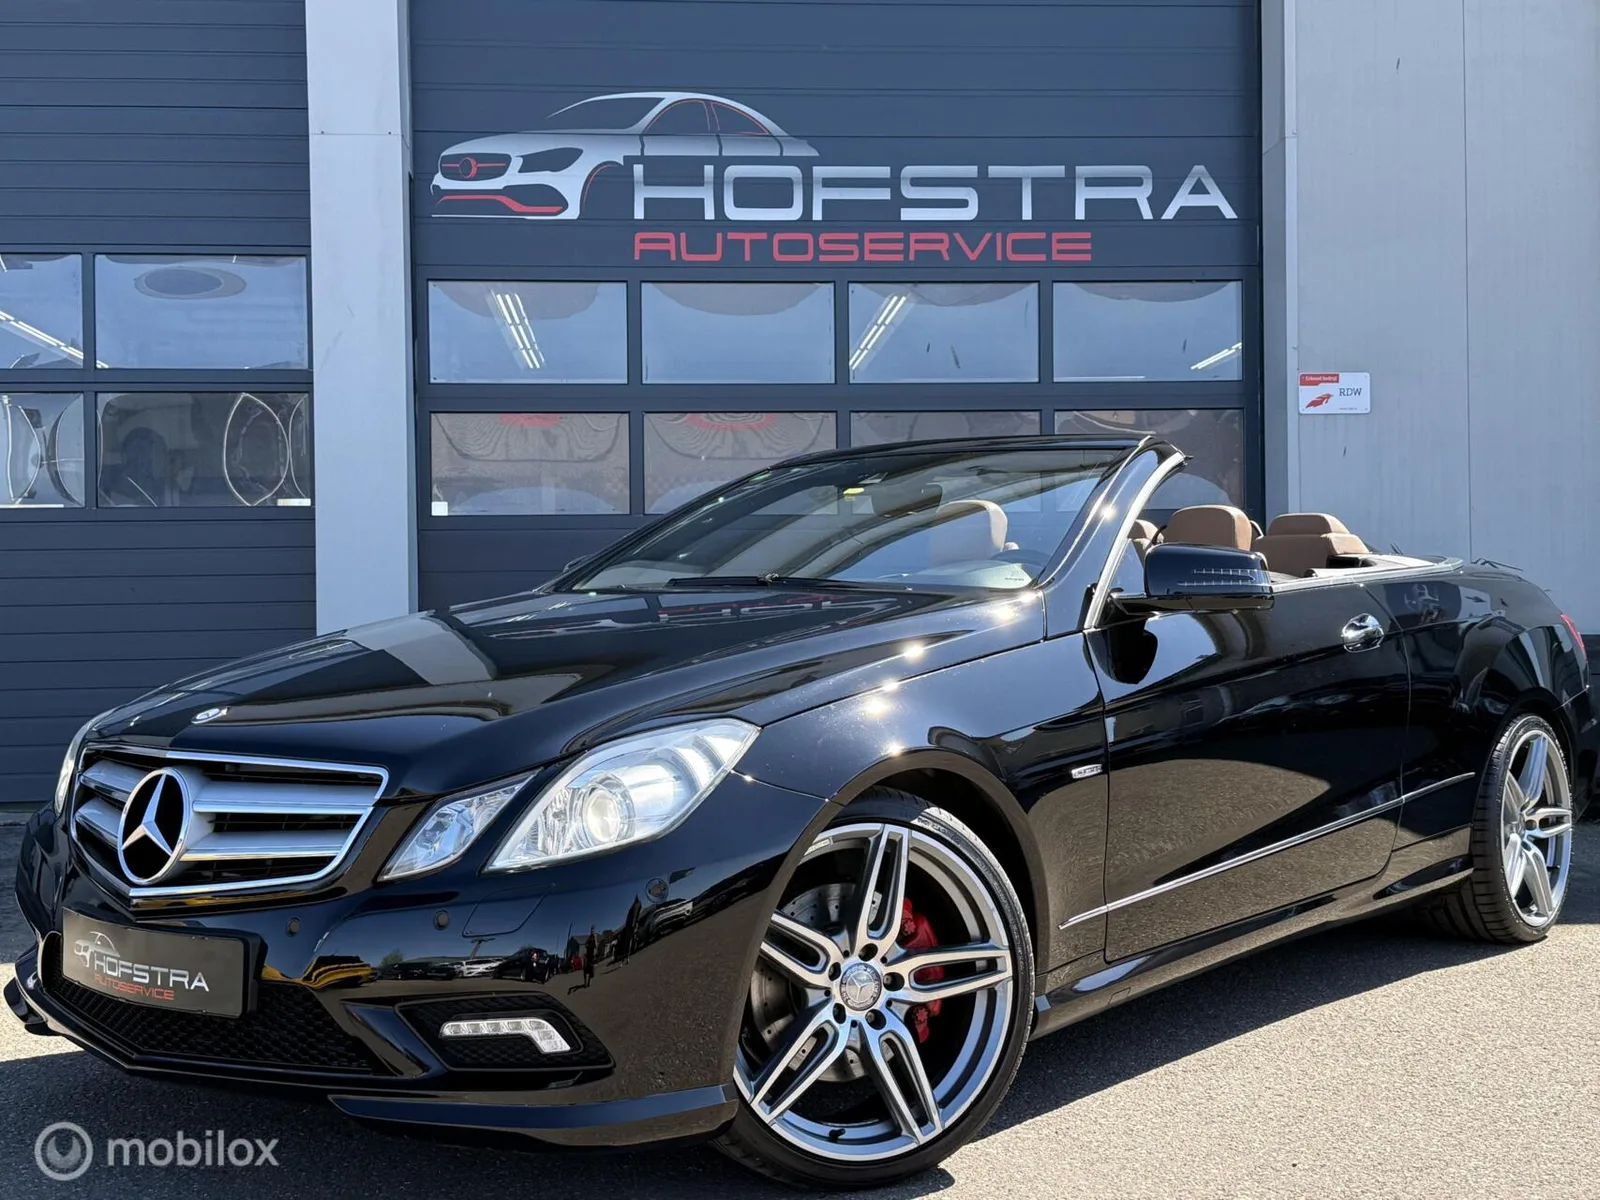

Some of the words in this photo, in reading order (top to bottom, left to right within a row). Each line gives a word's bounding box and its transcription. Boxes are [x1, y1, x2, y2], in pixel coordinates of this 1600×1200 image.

[633, 164, 1238, 221] HOFSTRA
[634, 232, 1092, 262] AUTOSERVICE
[1339, 387, 1362, 396] RDW
[94, 973, 176, 1000] AUTOSERVICE
[95, 956, 210, 992] HOFSTRA
